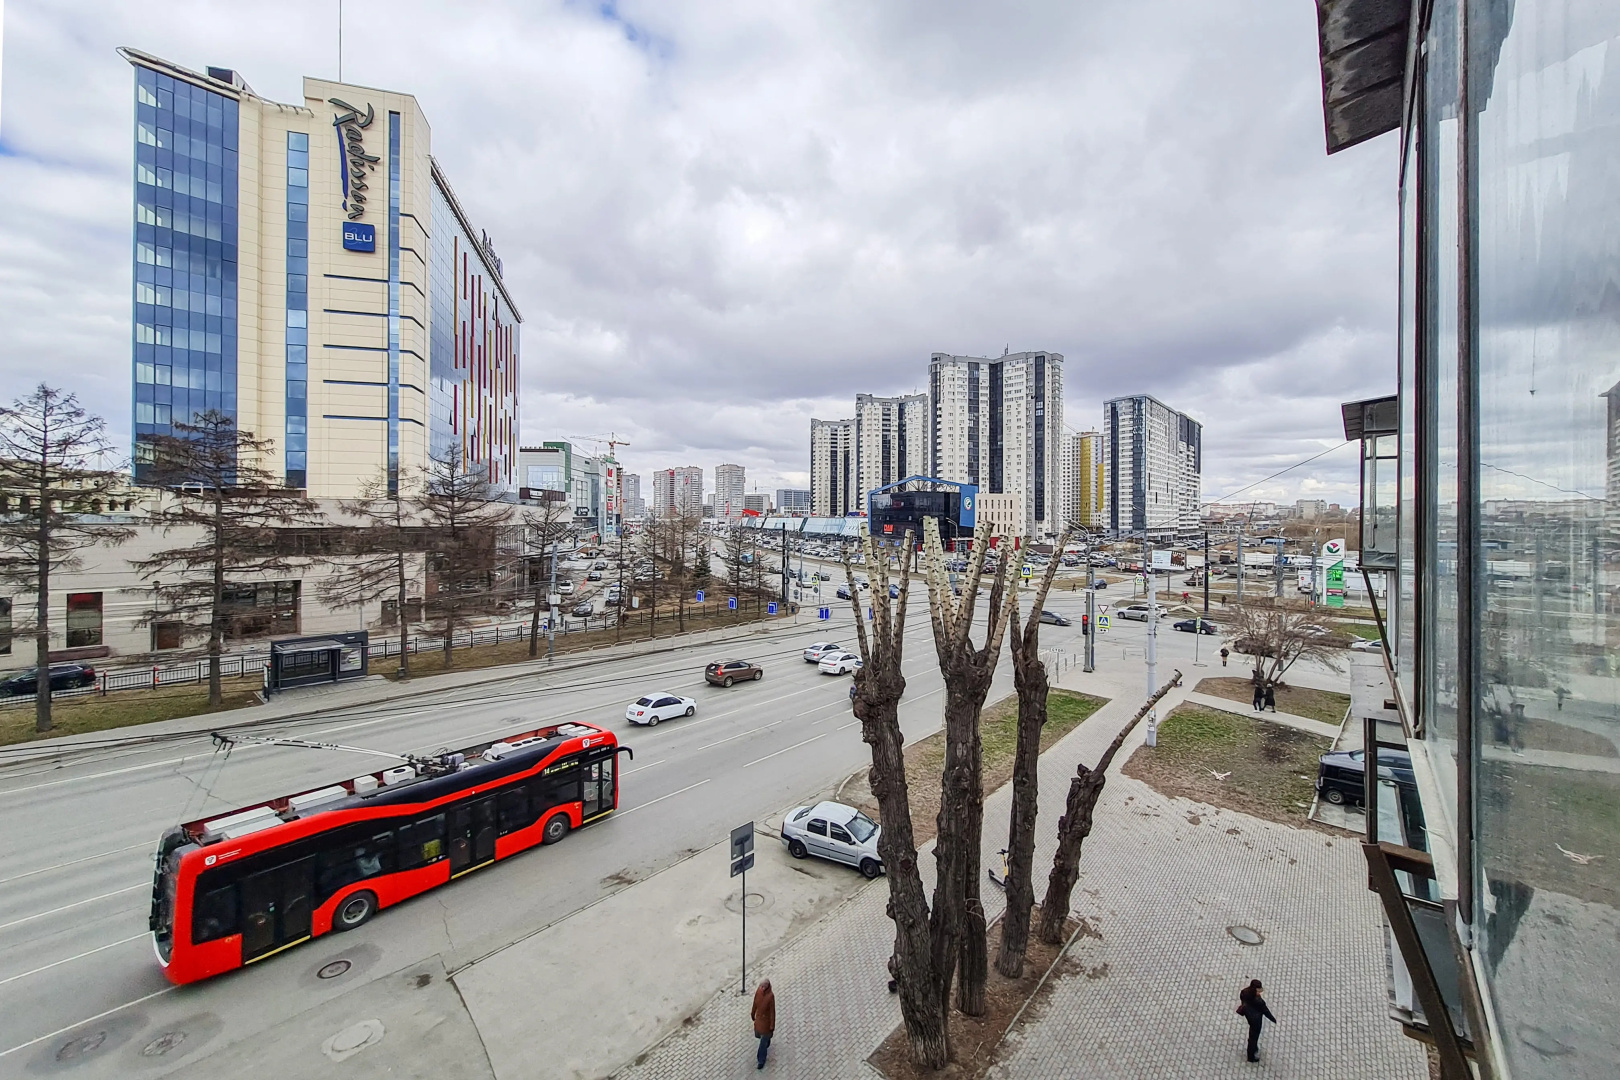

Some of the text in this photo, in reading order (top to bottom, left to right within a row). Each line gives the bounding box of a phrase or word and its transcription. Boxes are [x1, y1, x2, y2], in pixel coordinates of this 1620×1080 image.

[328, 98, 381, 220] Radisson
[344, 232, 373, 242] BLU
[544, 767, 550, 775] 14
